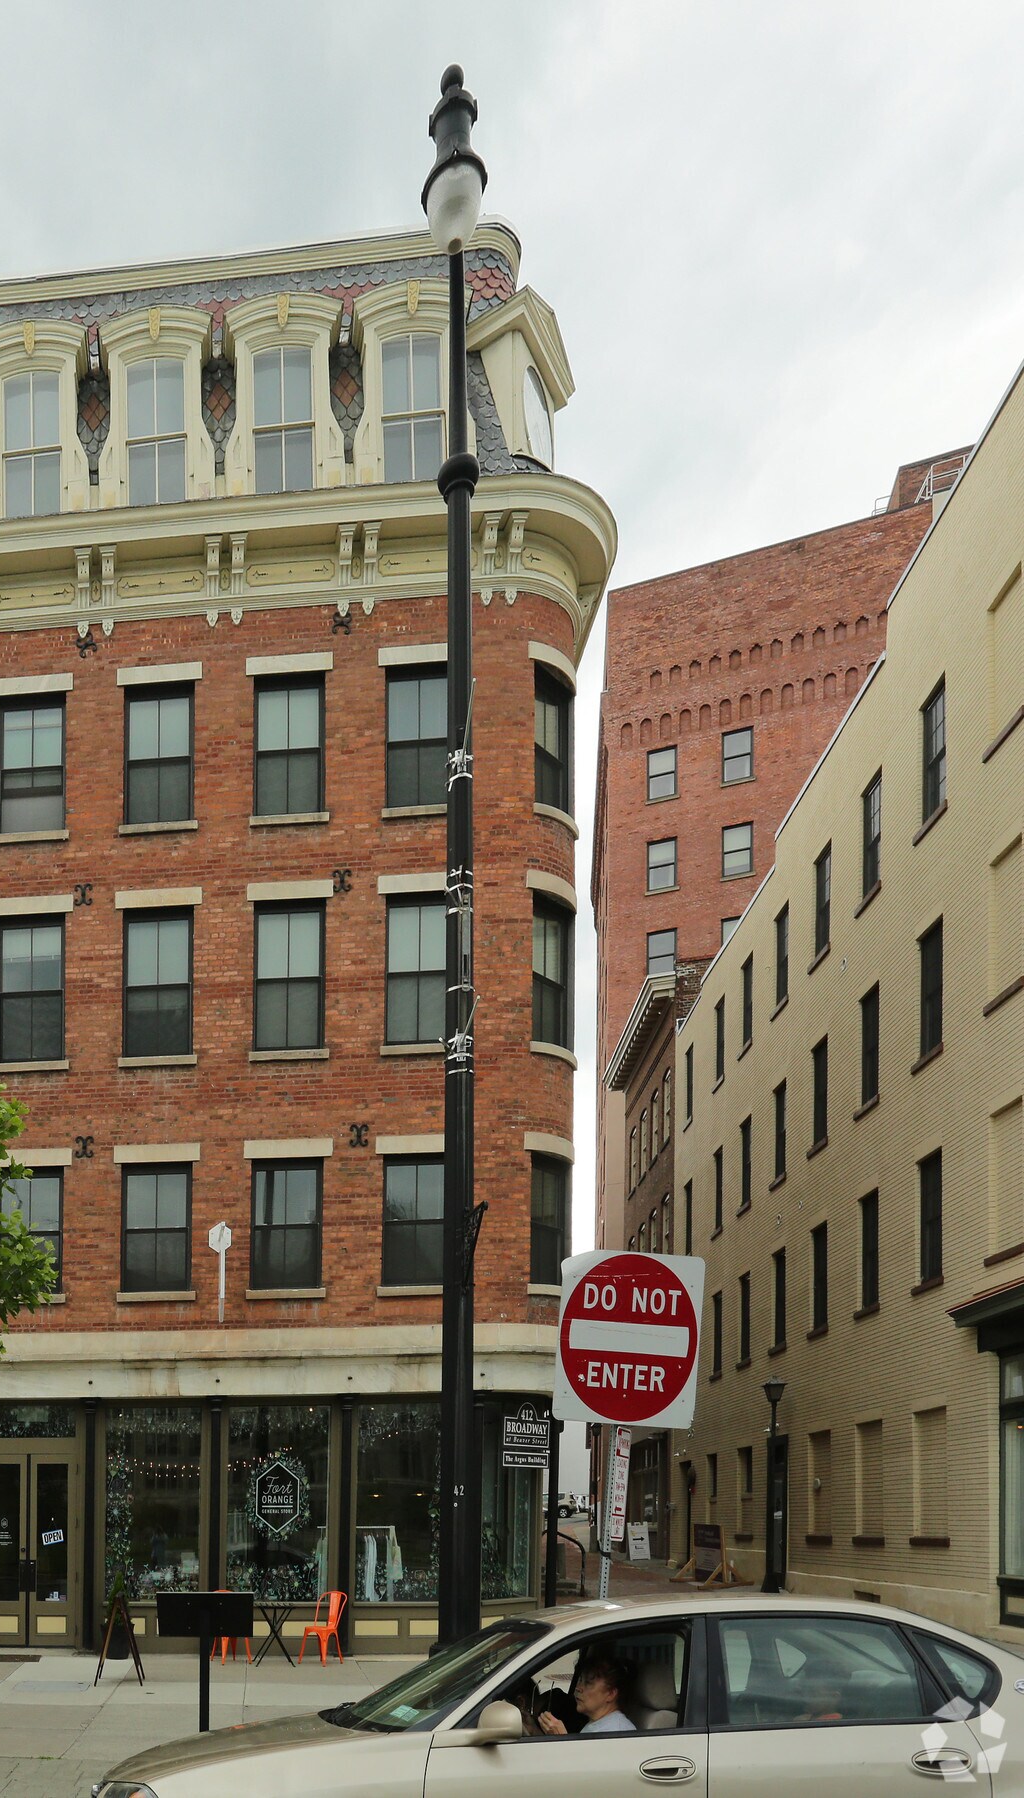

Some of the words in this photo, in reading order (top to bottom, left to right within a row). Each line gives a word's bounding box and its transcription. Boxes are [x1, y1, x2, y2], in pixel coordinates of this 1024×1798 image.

[584, 1283, 616, 1310] DO
[632, 1287, 681, 1315] NOT
[587, 1362, 665, 1392] ENTER
[521, 1410, 533, 1420] 412
[507, 1422, 547, 1434] BROADWAY
[528, 1457, 546, 1465] Building
[263, 1476, 293, 1494] Fort
[262, 1495, 293, 1503] ORANGE
[44, 1531, 62, 1544] OPEN
